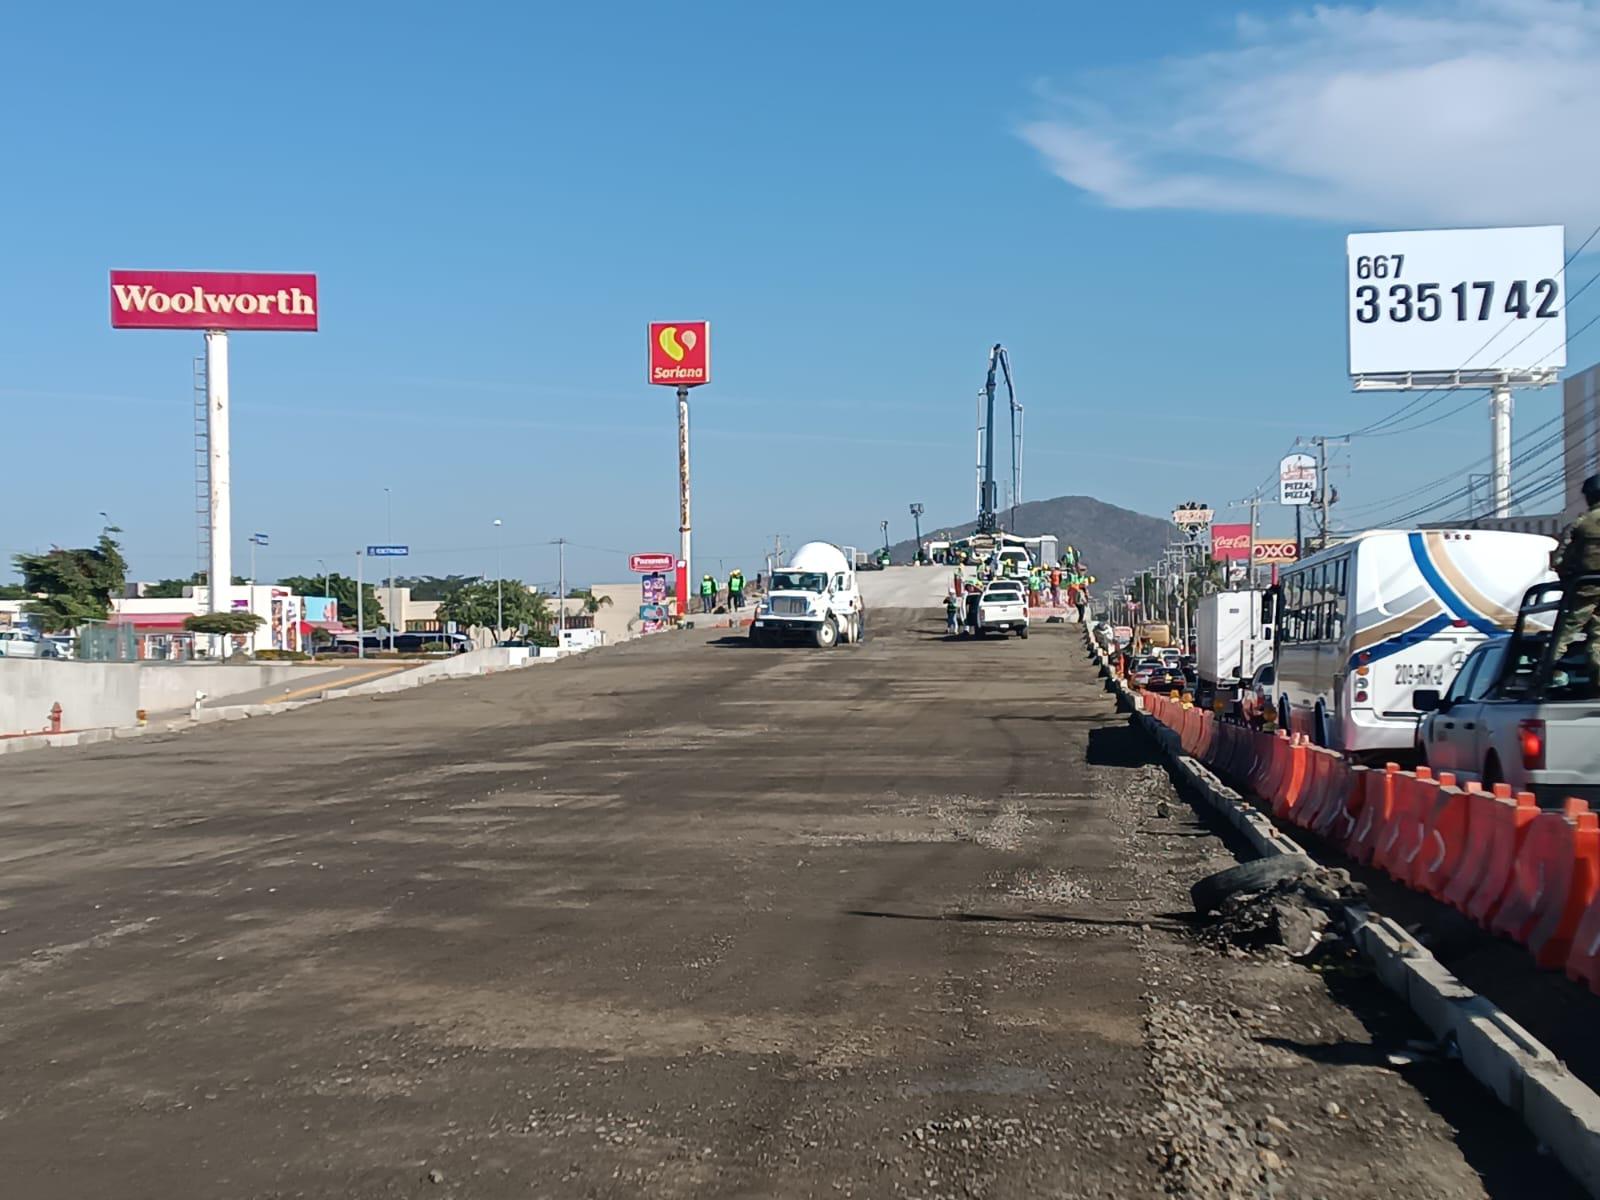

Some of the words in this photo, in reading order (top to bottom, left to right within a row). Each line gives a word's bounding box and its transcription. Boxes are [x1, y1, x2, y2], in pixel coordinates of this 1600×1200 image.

[1356, 254, 1404, 279] 667
[112, 284, 315, 315] Woolworth
[653, 366, 703, 379] Soriana
[1254, 543, 1296, 559] OXXO
